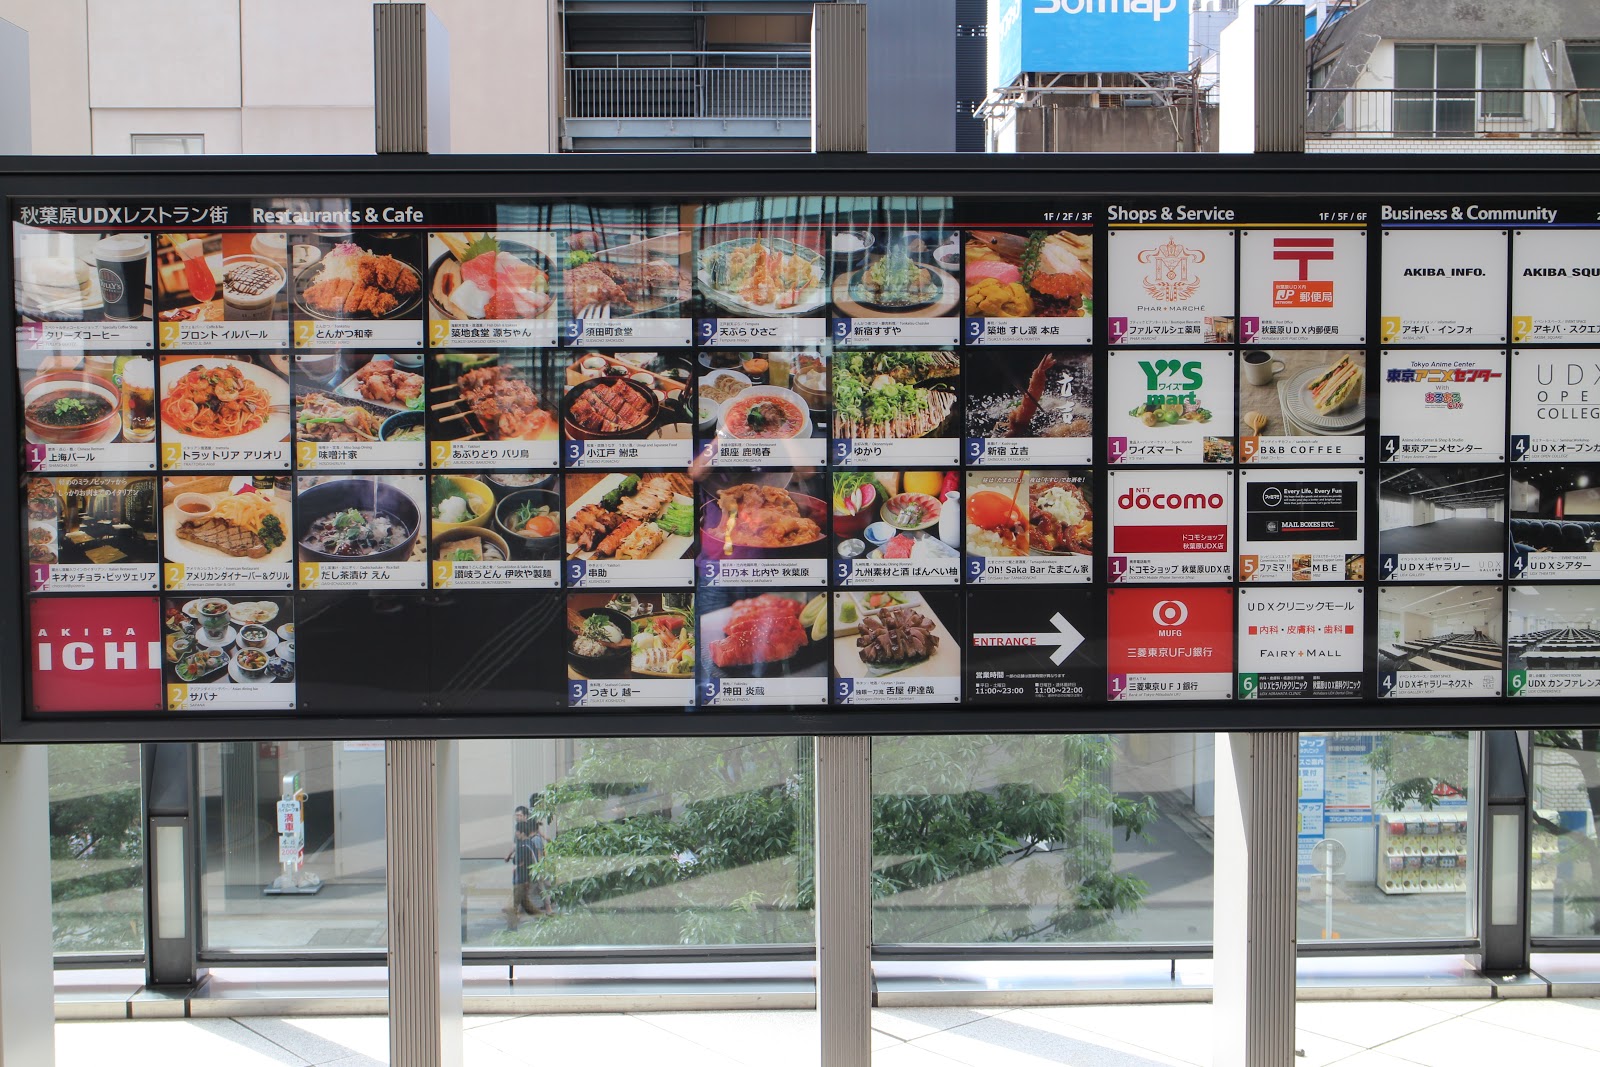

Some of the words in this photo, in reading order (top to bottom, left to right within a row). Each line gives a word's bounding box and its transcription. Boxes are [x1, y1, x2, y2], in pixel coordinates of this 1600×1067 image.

[21, 206, 228, 224] 秋葉原UDXレストラン街
[253, 208, 360, 223] Restaurants
[365, 208, 378, 222] &
[382, 206, 423, 223] Cafe
[1082, 212, 1092, 220] 3F
[1108, 205, 1157, 224] Shops
[1161, 206, 1173, 220] &
[1177, 205, 1234, 220] Service
[1357, 212, 1367, 220] 6F
[1382, 205, 1447, 220] Business
[1451, 206, 1463, 220] &
[1466, 205, 1557, 223] Community
[1300, 292, 1332, 302] 郵便局
[316, 329, 373, 339] とんかつ和幸
[451, 328, 490, 338] 築地食堂
[493, 328, 531, 337] 源ちゃん
[586, 327, 633, 337] 須田町食堂
[720, 327, 747, 336] 天ぷら
[752, 327, 777, 336] ひさご
[854, 326, 901, 335] 新宿すずや
[987, 326, 1006, 335] 築地
[1010, 326, 1038, 335] すし源
[1041, 326, 1059, 335] 本店
[1130, 325, 1200, 334] ファルマルシェ薬局
[1262, 325, 1338, 334] 秋葉原UDX内郵便局
[1403, 326, 1473, 334] アキバ・インフォ
[45, 330, 120, 340] タリーズコーヒー
[222, 330, 268, 340] イルバール
[1387, 369, 1502, 383] 東京アニメセンター
[1147, 391, 1196, 405] mart
[587, 448, 615, 457] 小江戸
[721, 447, 739, 457] 銀座
[742, 447, 771, 457] 鹿鳴春
[854, 447, 882, 456] ゆかり
[987, 447, 1007, 456] 新宿
[1010, 447, 1029, 456] 立吉
[1129, 446, 1182, 454] ワイズマート
[1291, 445, 1342, 453] COFFEE
[49, 452, 95, 461] 上海バール
[183, 451, 240, 459] トラットリア
[244, 451, 282, 459] アリオリ
[318, 450, 358, 459] 味噌汁家
[452, 450, 498, 459] あぶりどり
[1118, 488, 1223, 509] docomo
[987, 565, 1003, 574] Oh!
[1006, 565, 1027, 574] Saka
[1030, 565, 1045, 574] Bar
[1048, 565, 1089, 574] たまごん家
[1129, 565, 1179, 573] ドコモショップ
[1182, 565, 1230, 574] 秋葉原UDX店
[1313, 564, 1337, 572] MBE
[1400, 563, 1470, 571] UDXギャラリー
[1530, 562, 1592, 570] UDXシアター
[321, 570, 368, 579] だし茶漬け
[372, 570, 390, 579] えん
[455, 570, 501, 579] 讃岐うどん
[505, 569, 551, 579] 伊吹や製麺
[588, 568, 607, 577] 串助
[722, 569, 749, 577] 日乃本
[752, 568, 779, 577] 比内や
[782, 568, 809, 577] 秋葉原
[855, 567, 910, 577] 九州素材と酒
[1248, 602, 1354, 611] UDXクリニックモール
[38, 628, 135, 636] AKIBA
[973, 637, 1037, 647] ENTRANCE
[1128, 648, 1212, 658] 三菱東京UFJ銀行
[1260, 649, 1295, 657] FAIRY
[1307, 649, 1341, 657] MALL
[886, 686, 904, 695] 舌屋
[908, 686, 934, 695] 伊達哉
[1129, 682, 1198, 691] 三菱東京UFJ銀行
[590, 688, 618, 697] つきじ
[621, 687, 640, 697] 越一
[722, 687, 742, 696] 神田
[745, 687, 765, 696] 炎蔵
[190, 692, 218, 701] サバナ
